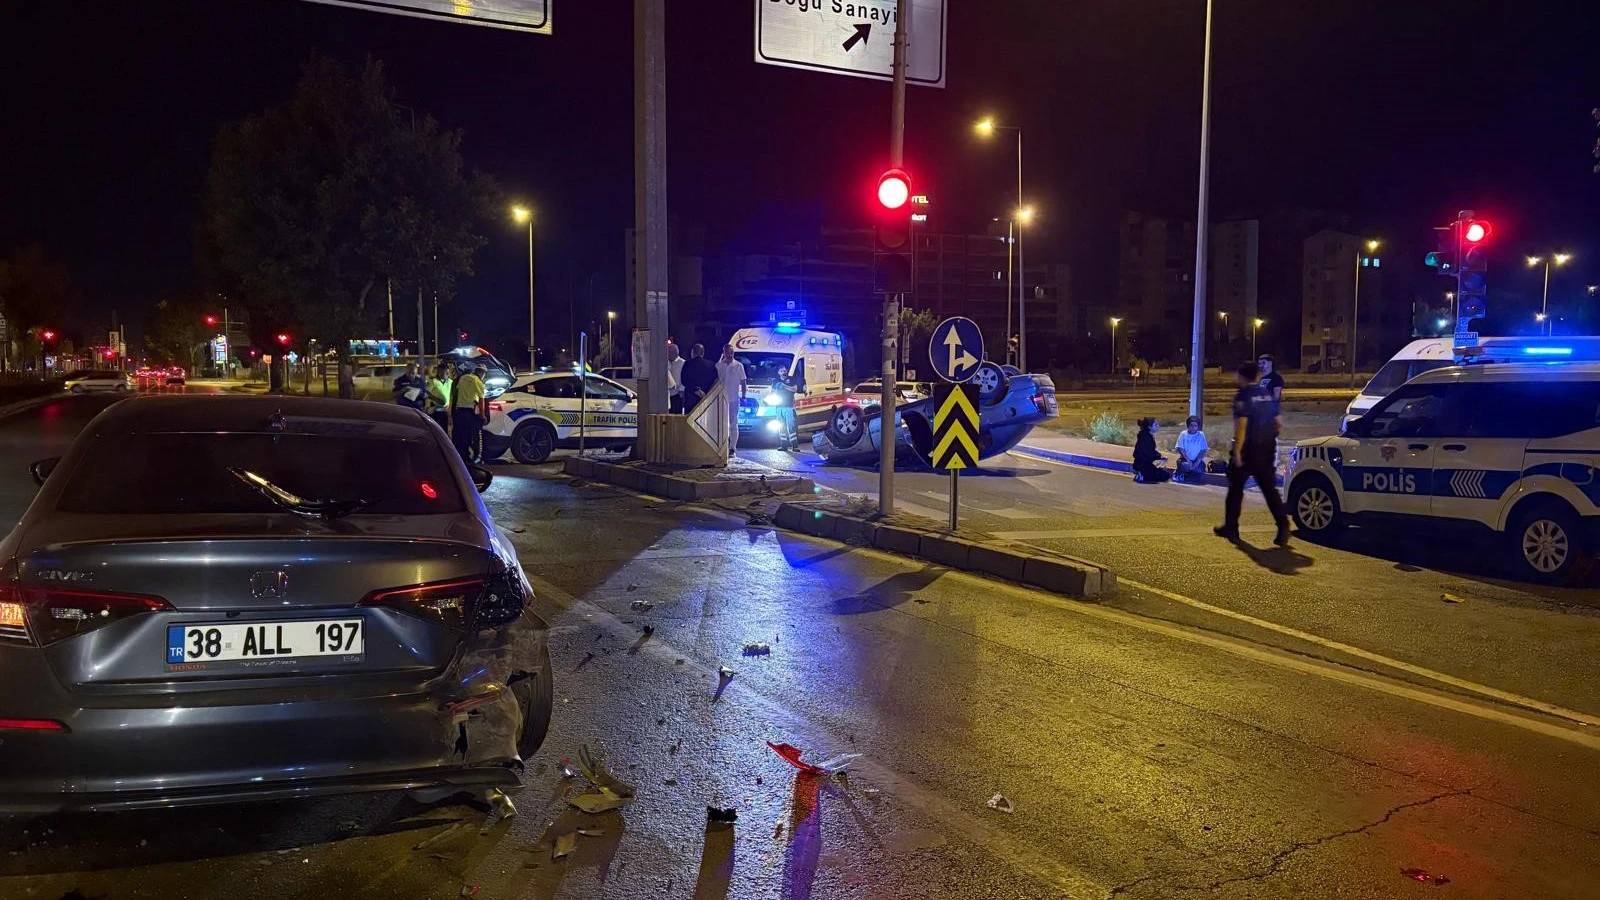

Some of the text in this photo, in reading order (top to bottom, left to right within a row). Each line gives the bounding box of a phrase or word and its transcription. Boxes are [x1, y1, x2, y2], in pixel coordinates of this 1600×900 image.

[831, 0, 897, 26] Sanayi
[593, 415, 637, 424] TRAFİK POLİS
[1363, 468, 1416, 493] POLİS
[169, 647, 183, 656] TR
[187, 622, 360, 658] 38 ALL 197
